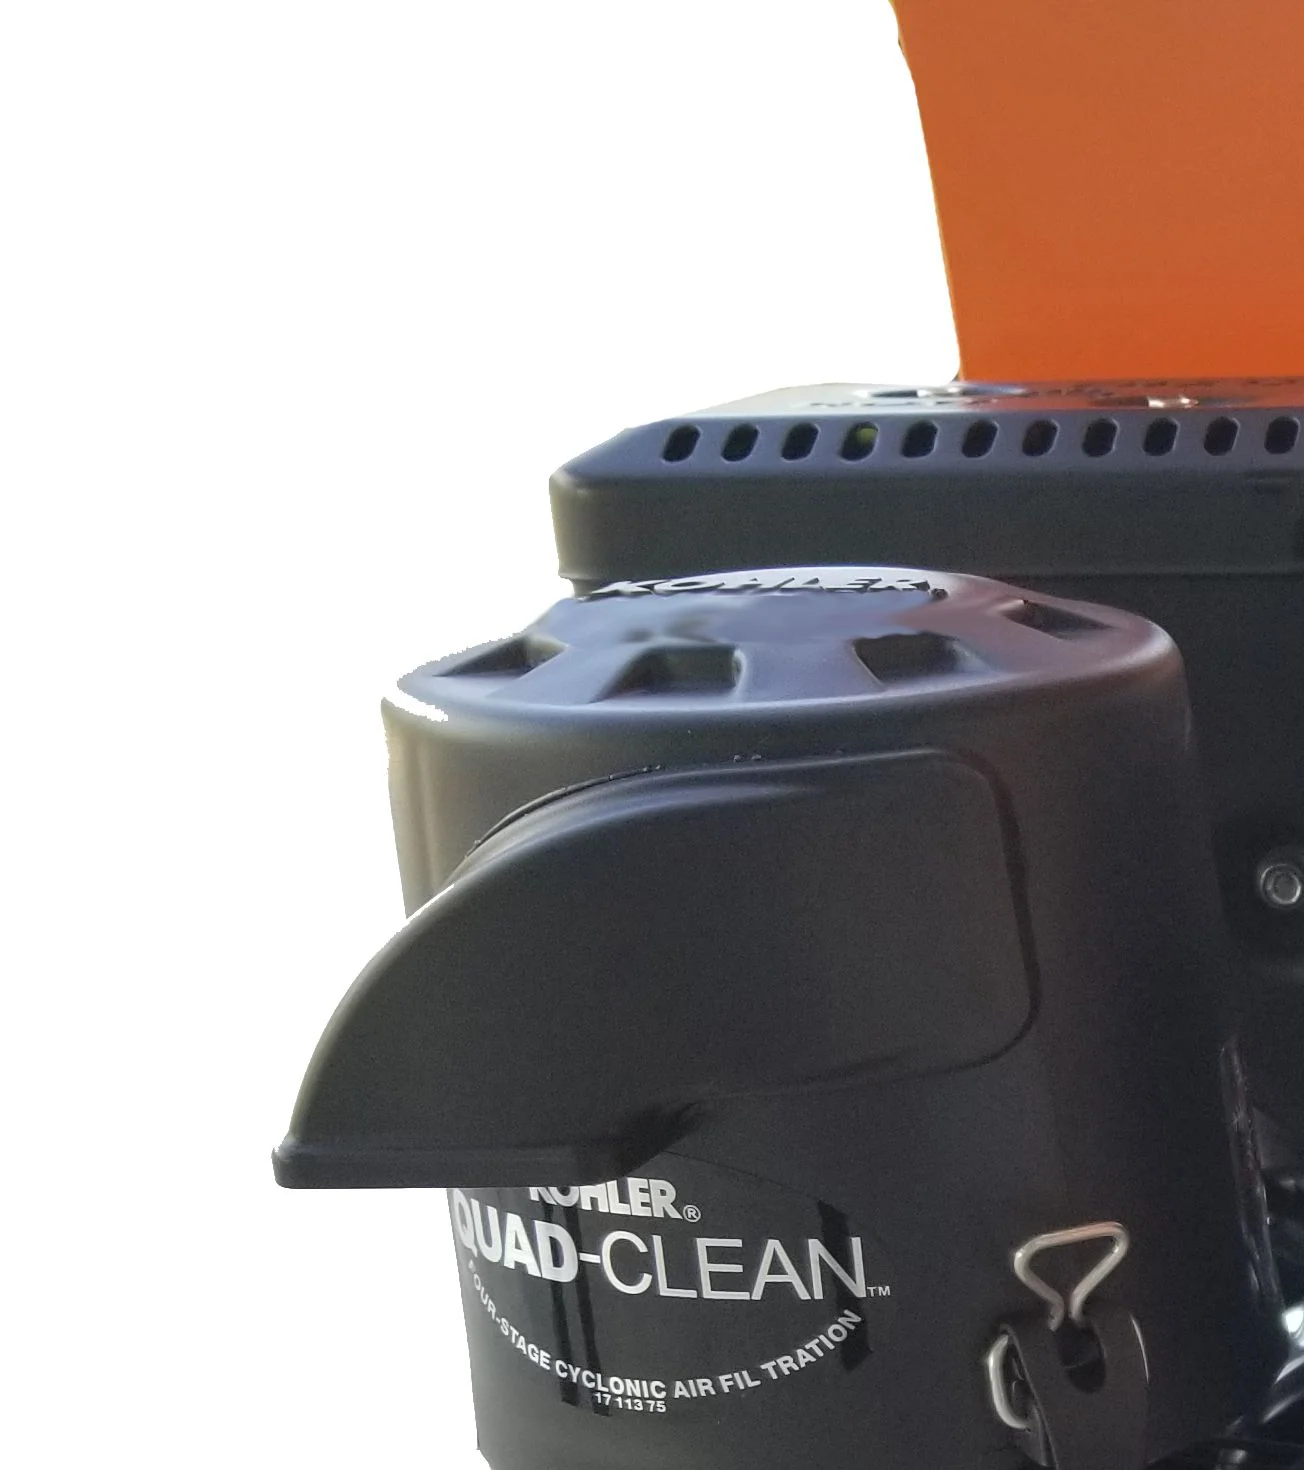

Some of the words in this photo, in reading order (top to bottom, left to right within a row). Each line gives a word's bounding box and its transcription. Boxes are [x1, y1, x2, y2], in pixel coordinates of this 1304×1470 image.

[555, 1360, 667, 1399] CYCLONIC
[674, 1379, 716, 1399] AIR
[595, 1392, 612, 1406] 17
[616, 1397, 644, 1412] 113
[649, 1400, 667, 1414] 75
